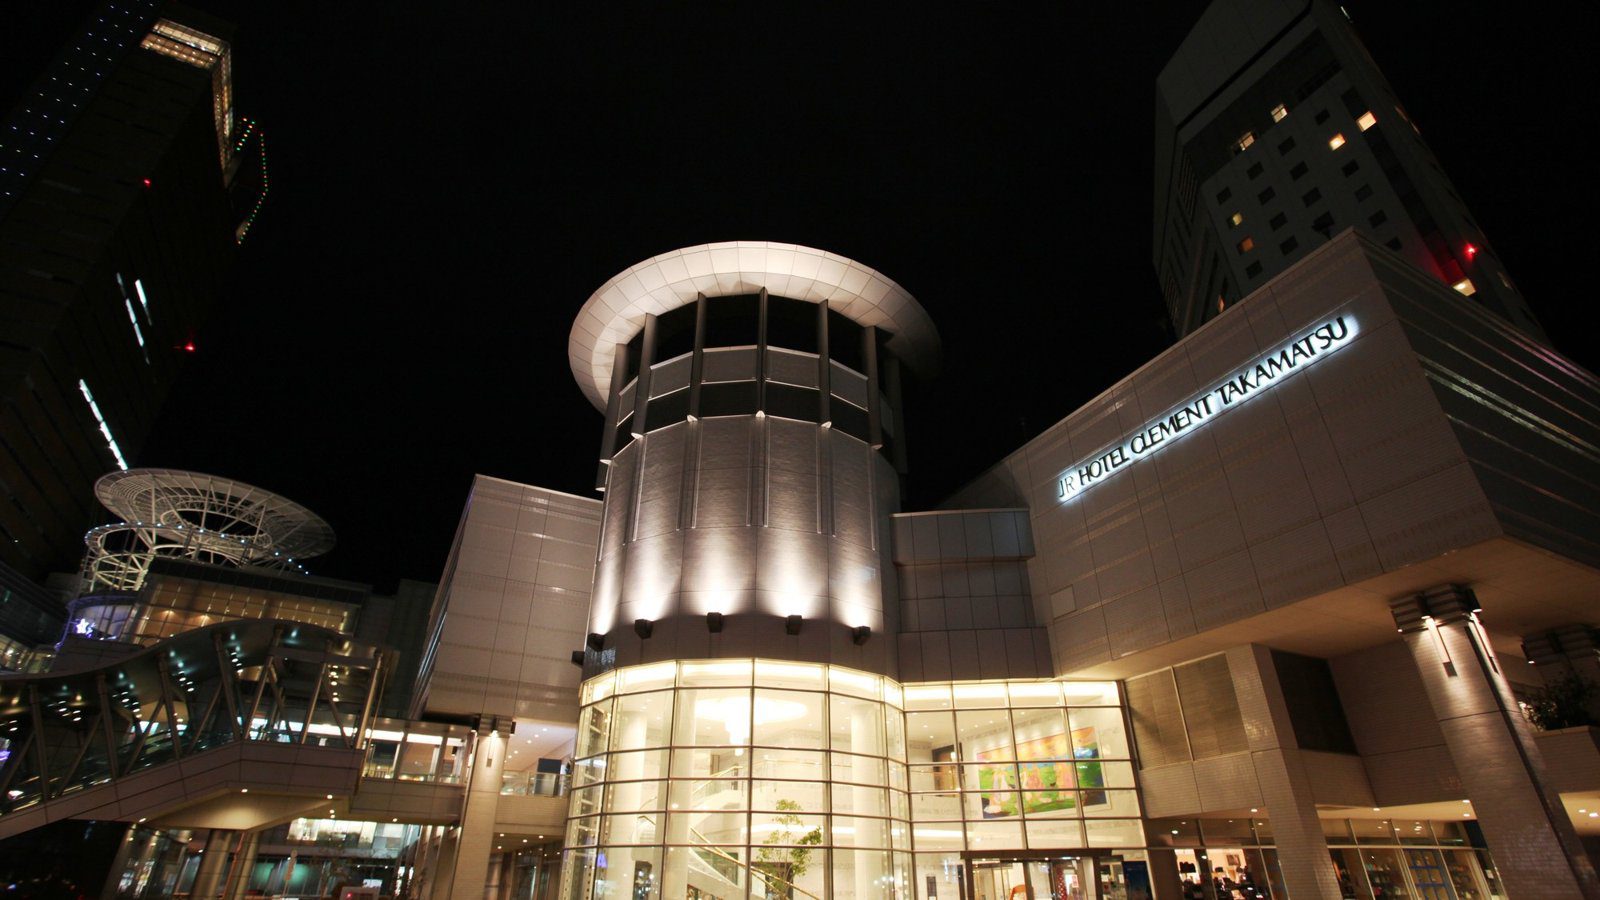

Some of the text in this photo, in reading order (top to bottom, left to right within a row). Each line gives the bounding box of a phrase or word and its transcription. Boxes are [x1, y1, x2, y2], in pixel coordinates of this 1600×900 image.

[1059, 316, 1348, 497] JR HOTEL CLEMENT TAKAMATSU
